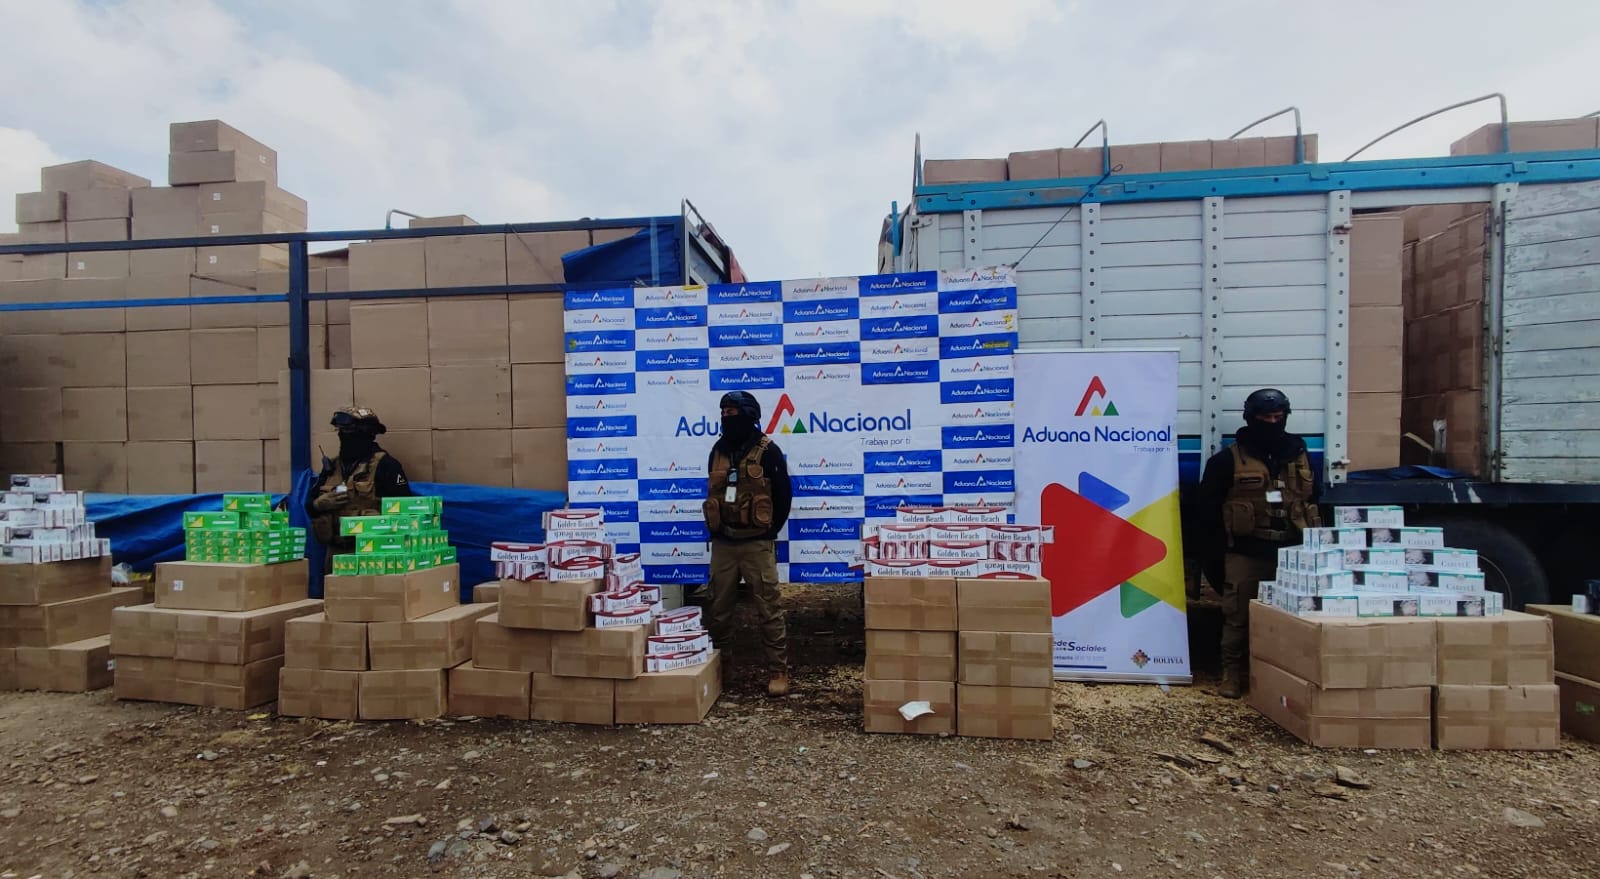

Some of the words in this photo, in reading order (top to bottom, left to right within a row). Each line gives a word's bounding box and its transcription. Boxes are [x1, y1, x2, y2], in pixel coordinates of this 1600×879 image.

[749, 288, 772, 296] Nacional
[902, 324, 927, 332] Nacional
[872, 370, 894, 378] Aduana
[904, 369, 928, 377] Nacional
[809, 409, 911, 433] Nacional
[1022, 426, 1091, 443] Aduana
[1094, 425, 1171, 442] Nacional
[860, 437, 889, 447] Trabaja
[890, 439, 902, 447] por
[981, 514, 1000, 522] Beach
[877, 568, 900, 576] Golden
[902, 568, 922, 576] Beach
[1153, 656, 1184, 664] BOLIVIA
